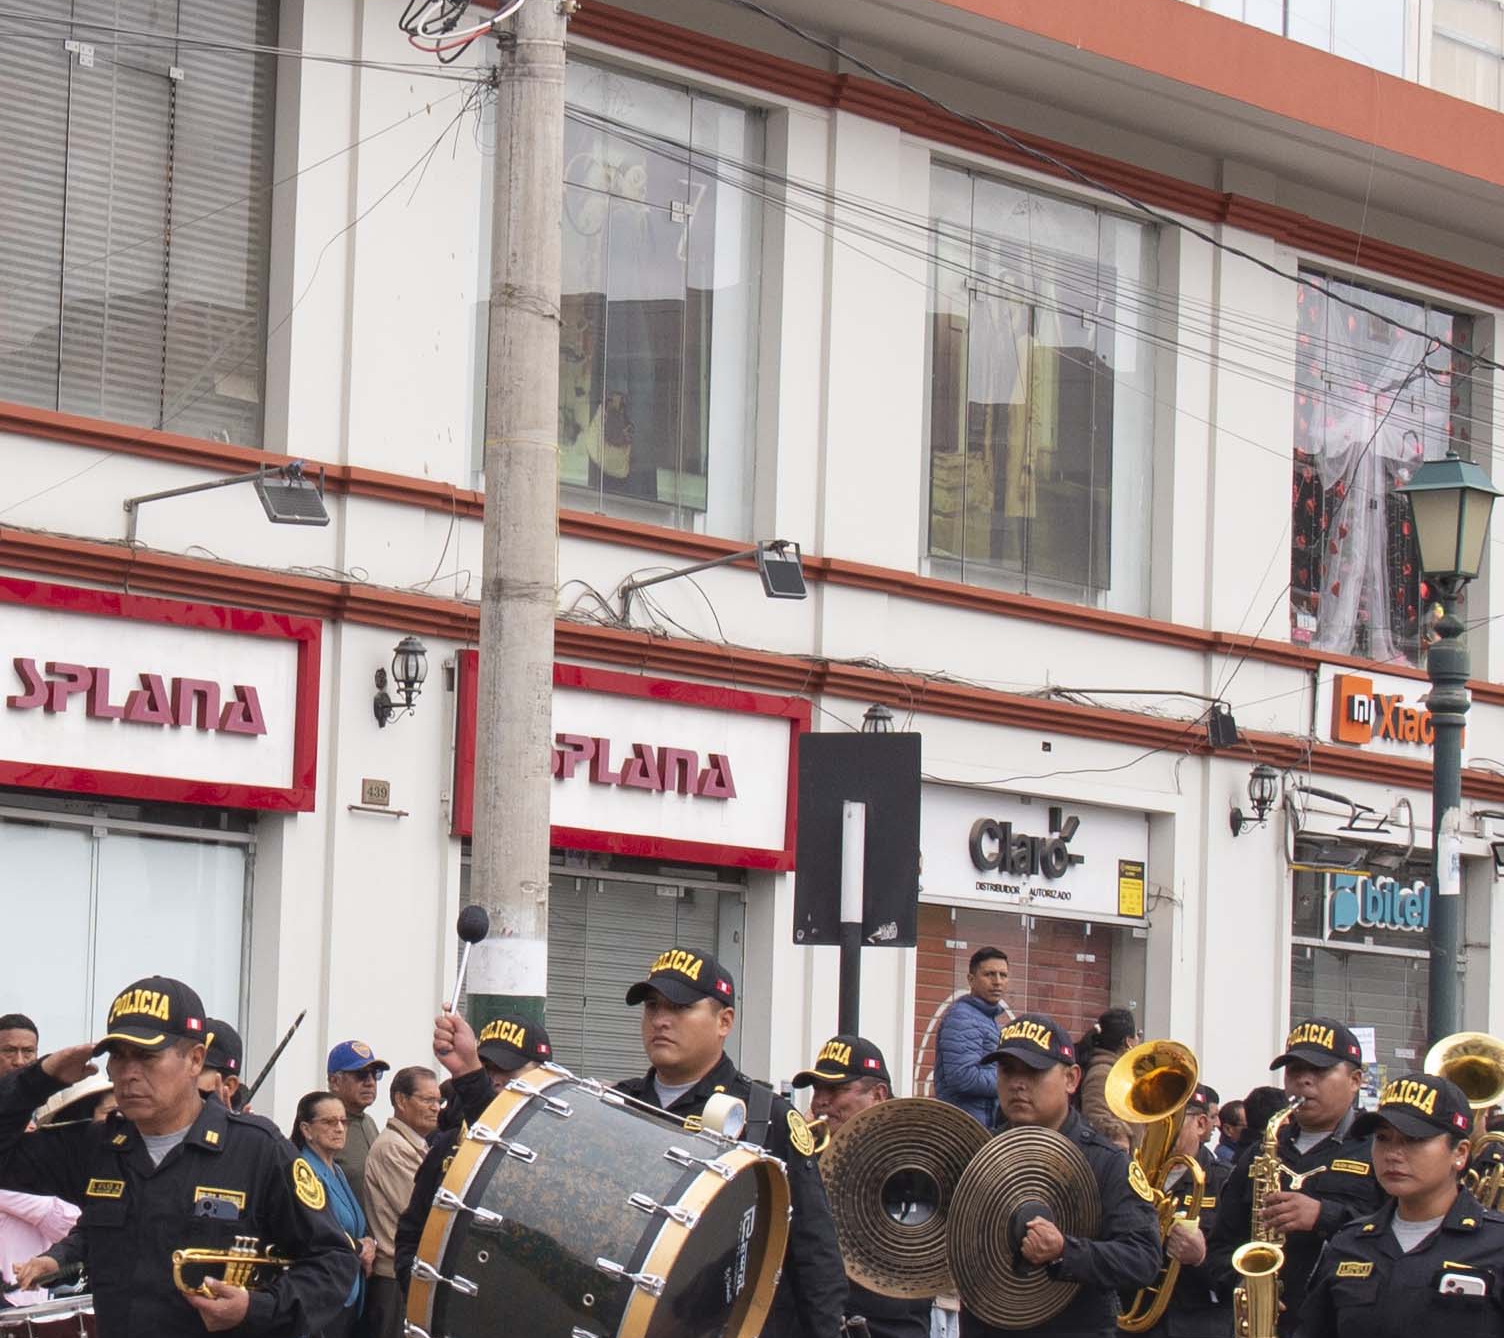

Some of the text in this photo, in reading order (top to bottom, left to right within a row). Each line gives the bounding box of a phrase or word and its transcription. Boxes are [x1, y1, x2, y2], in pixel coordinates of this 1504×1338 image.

[6, 658, 268, 736] SPLANA
[1378, 693, 1466, 749] Xiao
[550, 733, 737, 799] PLANA
[367, 786, 388, 798] 439
[969, 816, 1072, 880] Claro
[975, 881, 1072, 901] DISTRIBUIDOR AUTORIZADO
[1363, 877, 1431, 929] bitel
[649, 949, 704, 981] OLICIA
[109, 988, 171, 1024] POLICIA
[1379, 1079, 1439, 1116] OLICIA
